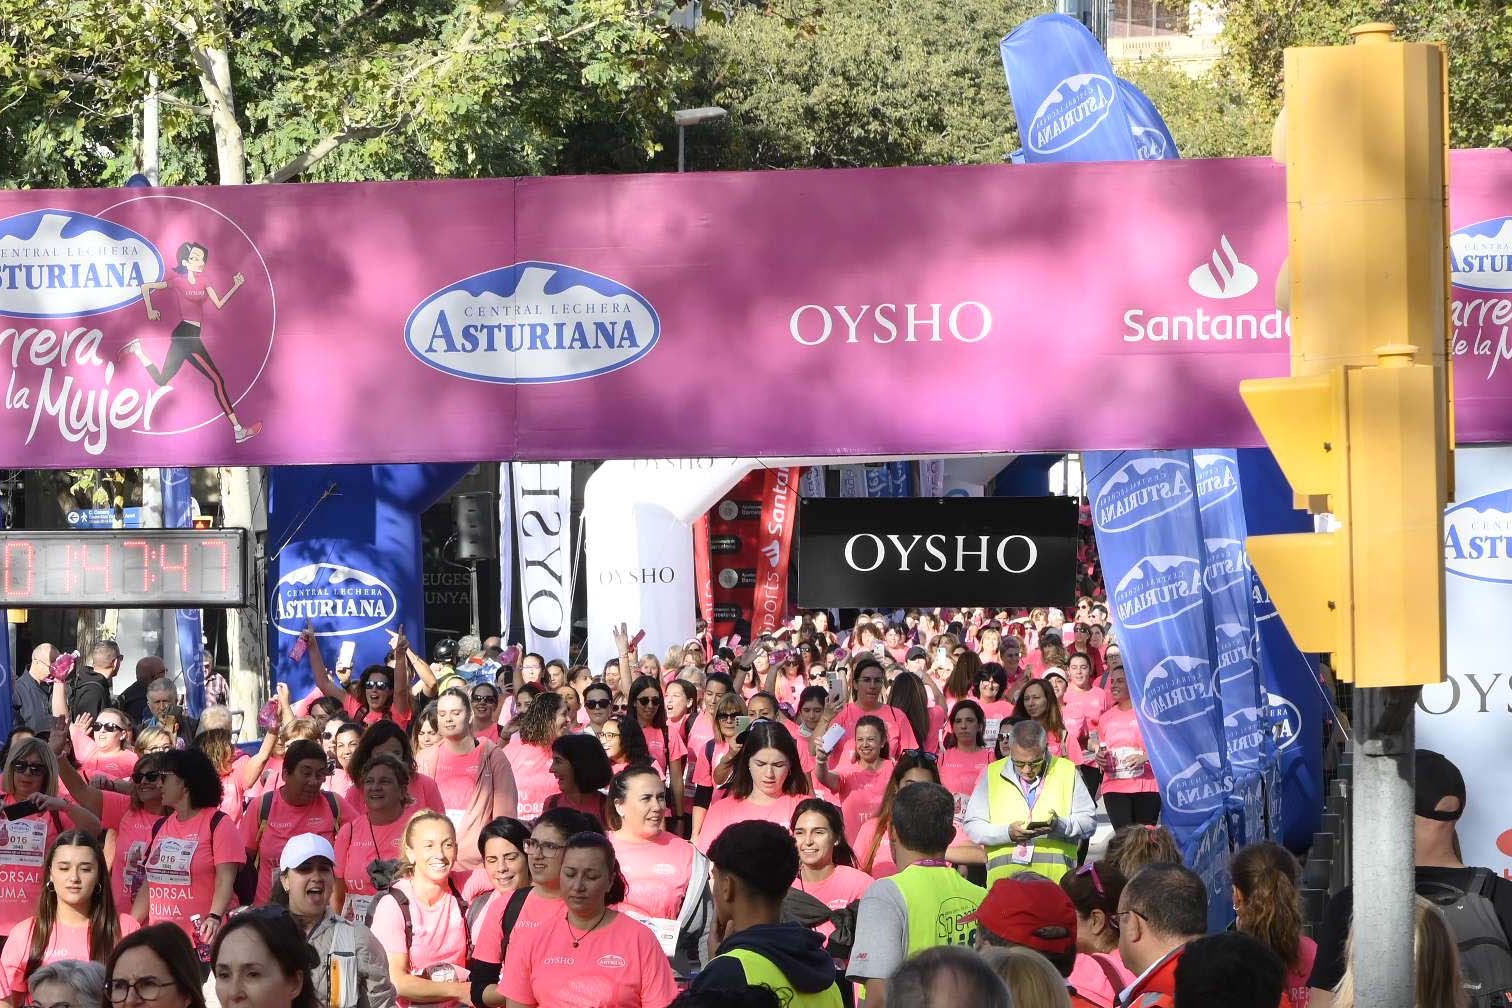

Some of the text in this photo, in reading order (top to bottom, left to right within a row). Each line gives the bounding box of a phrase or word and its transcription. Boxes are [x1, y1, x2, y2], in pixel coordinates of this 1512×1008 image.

[464, 302, 632, 316] CENTRAL LECHERA
[425, 309, 640, 354] ASTURIANA
[789, 301, 991, 345] OYSHO
[1473, 328, 1492, 356] la
[5, 372, 29, 409] la
[24, 360, 174, 455] Mujer
[843, 533, 1038, 573] OYSHO
[4, 541, 229, 597] 01:47:47
[598, 566, 676, 587] OYSHO
[287, 588, 383, 598] CENTRAL LECHERA
[274, 593, 388, 621] ASTURIANA
[10, 836, 28, 844] 016
[160, 855, 176, 863] 016
[149, 888, 194, 900] DORSAL
[150, 903, 183, 916] SUMA
[544, 957, 575, 966] OYSHO
